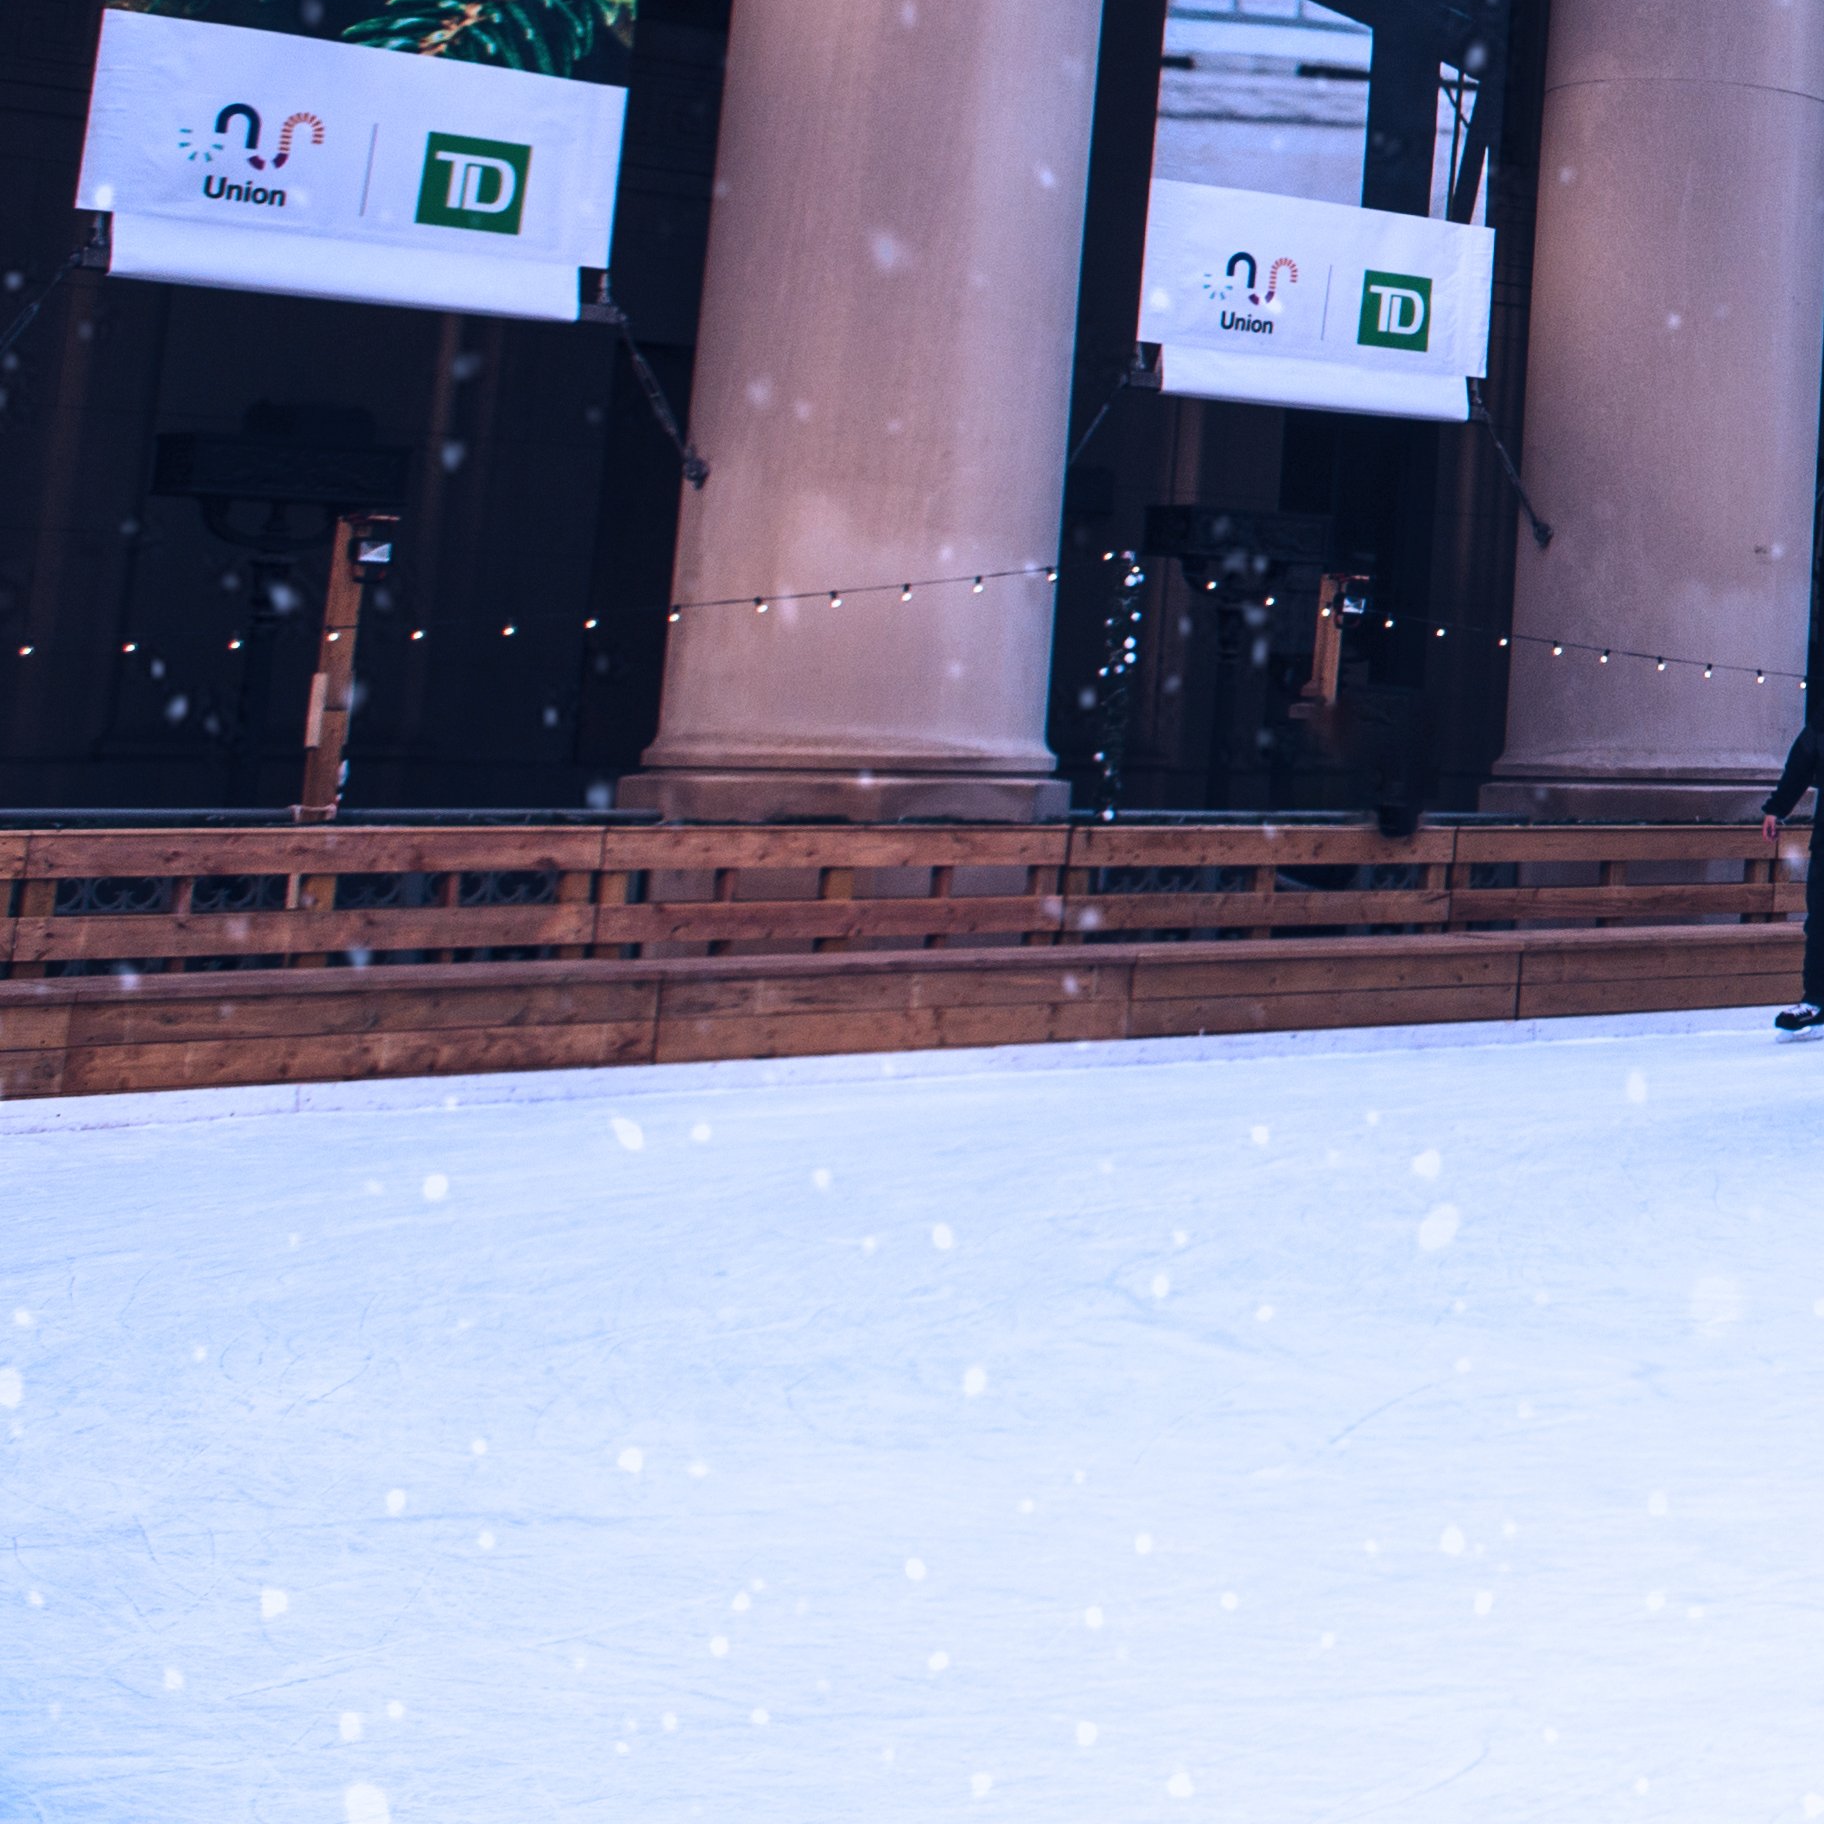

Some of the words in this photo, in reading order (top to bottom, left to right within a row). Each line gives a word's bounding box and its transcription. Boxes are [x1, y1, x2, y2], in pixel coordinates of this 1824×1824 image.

[203, 174, 287, 207] Union
[434, 150, 519, 214] TD
[1220, 310, 1274, 335] Union
[1369, 284, 1425, 336] TD
